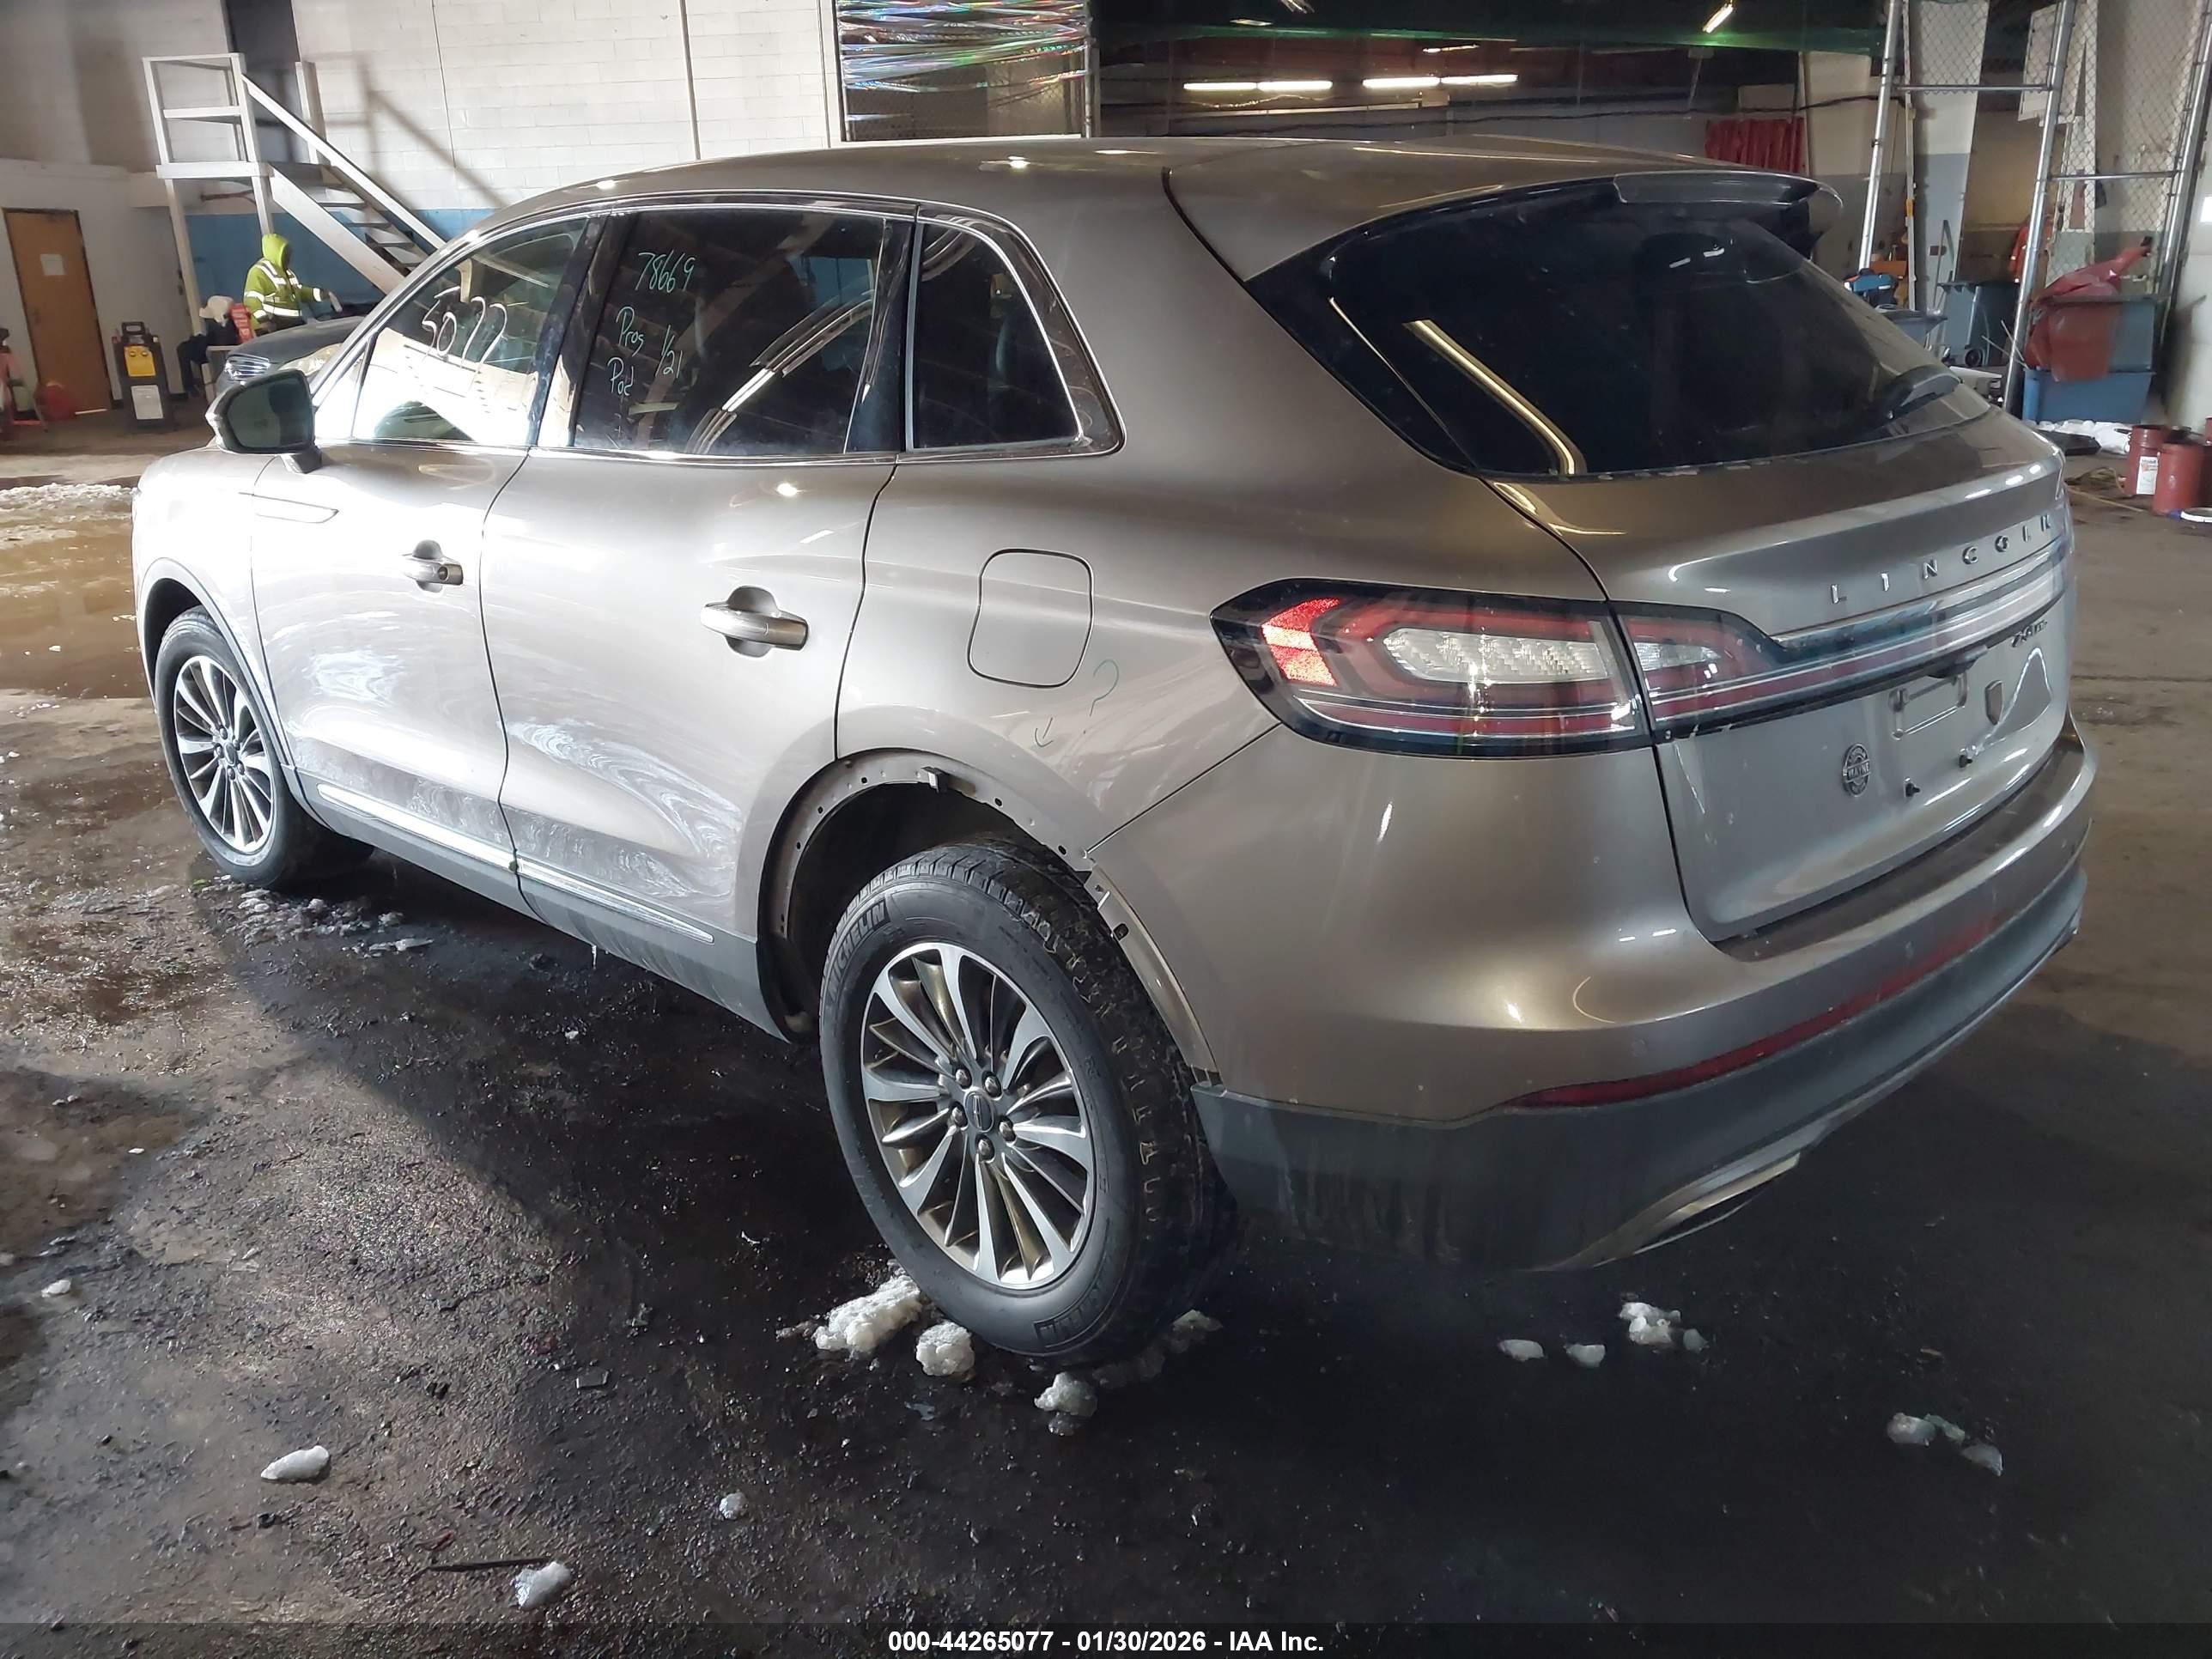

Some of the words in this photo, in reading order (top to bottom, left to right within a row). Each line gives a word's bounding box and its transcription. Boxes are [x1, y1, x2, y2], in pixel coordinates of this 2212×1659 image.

[635, 250, 696, 294] 78669
[421, 285, 507, 371] 5077
[1830, 513, 2051, 604] LINCOLN
[827, 901, 886, 1003] MICHELIN
